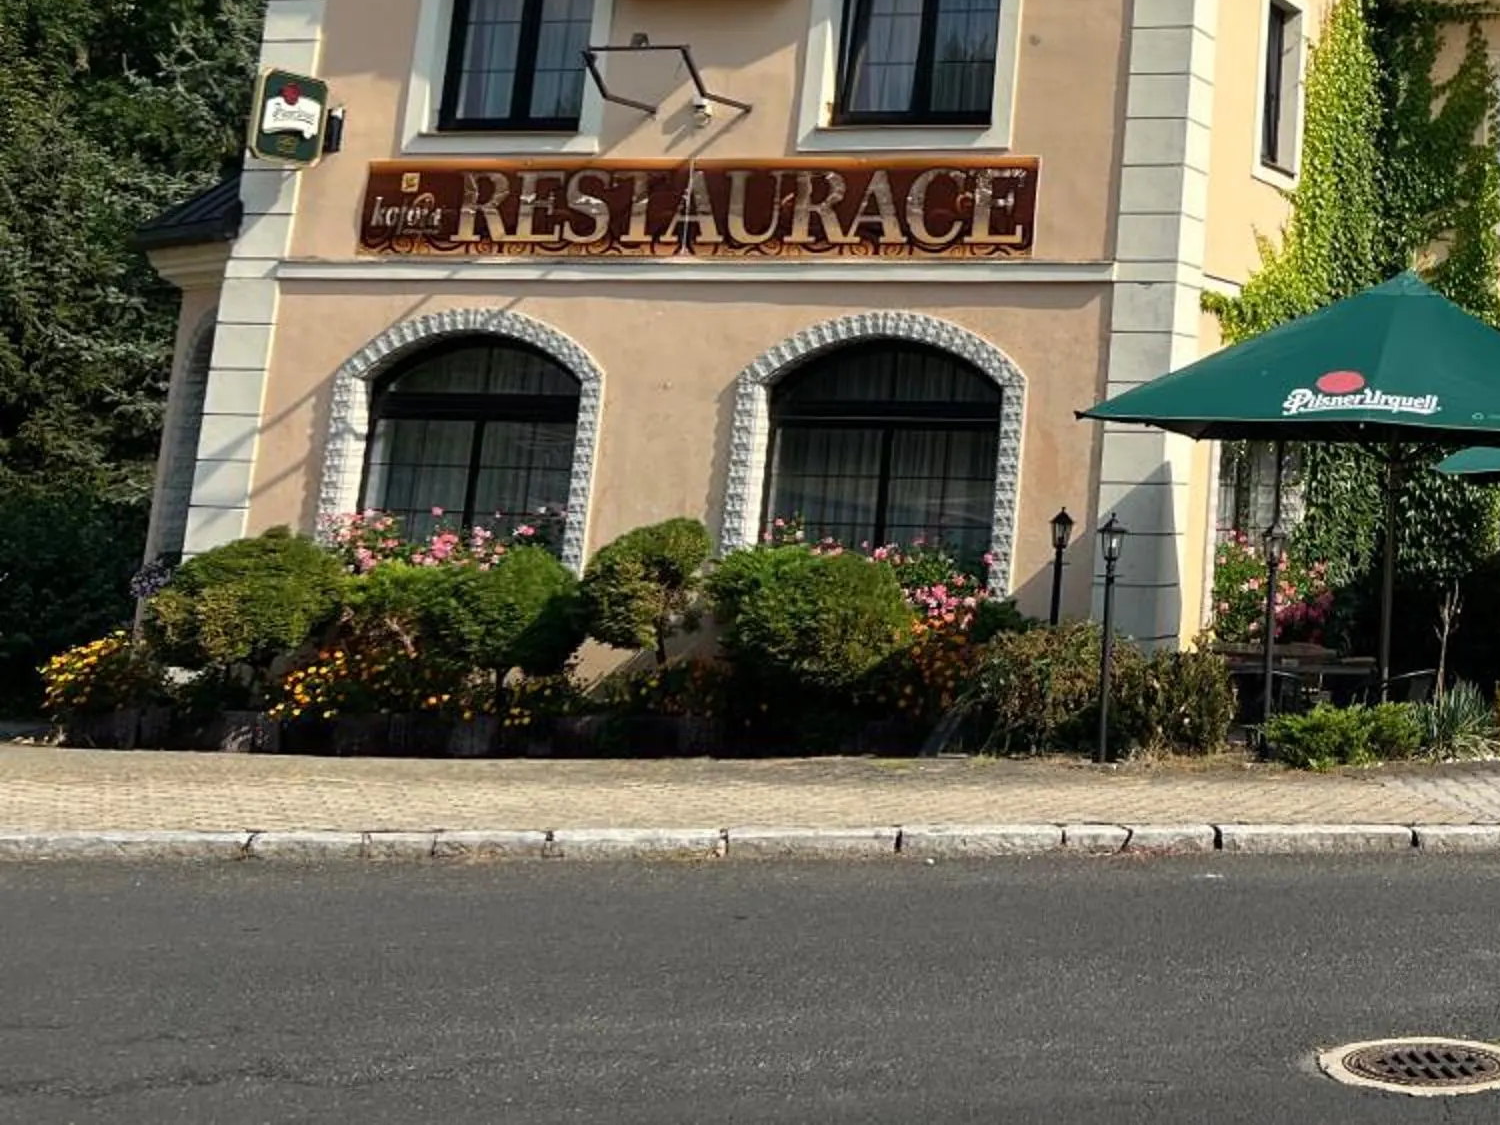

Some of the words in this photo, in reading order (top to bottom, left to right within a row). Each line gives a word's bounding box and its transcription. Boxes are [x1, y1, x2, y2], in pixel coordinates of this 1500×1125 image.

[449, 169, 1028, 244] RESTAURACE
[1282, 388, 1364, 416] Pilsner
[1363, 386, 1439, 415] Urquell
